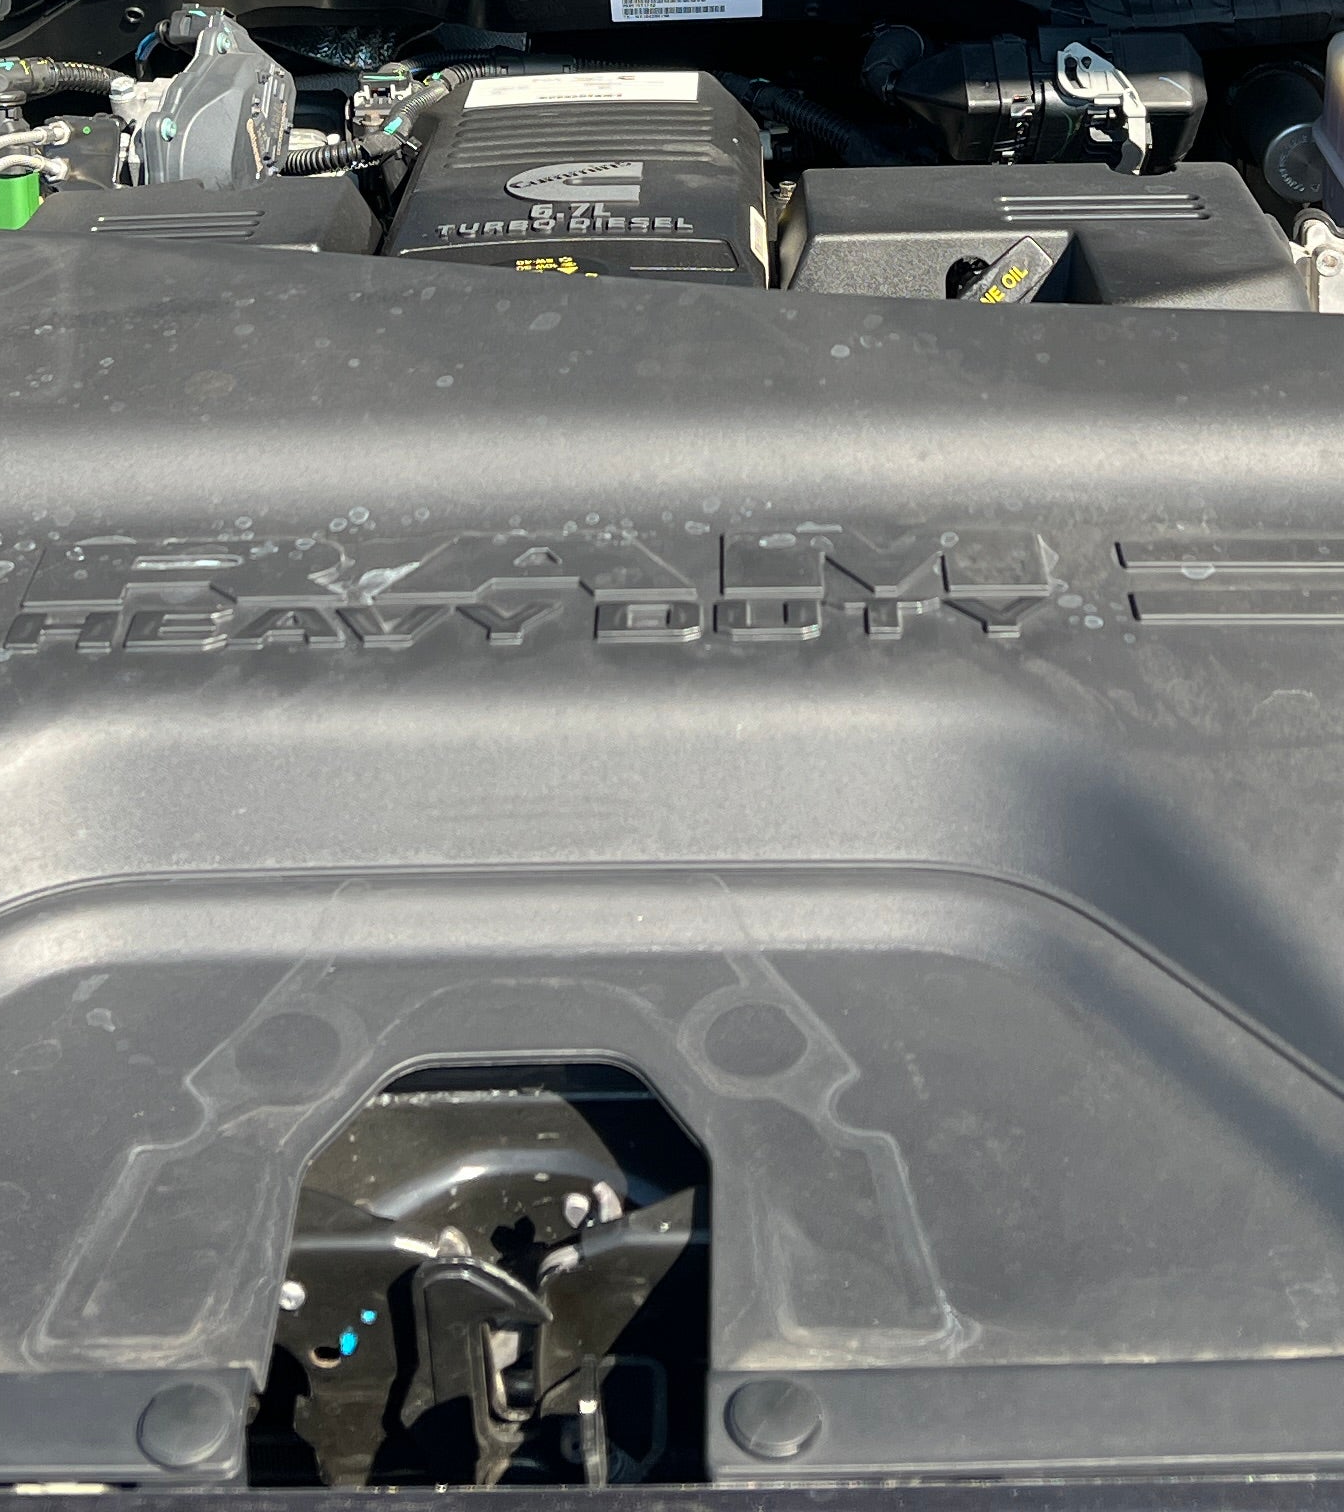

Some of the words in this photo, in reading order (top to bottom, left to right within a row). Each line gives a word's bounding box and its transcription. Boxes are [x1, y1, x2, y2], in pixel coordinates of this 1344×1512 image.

[509, 160, 634, 189] Cummins
[529, 202, 612, 222] 6.7L
[436, 219, 557, 239] TURBO
[567, 216, 694, 234] DIESEL
[1001, 265, 1029, 290] OIL
[19, 532, 1056, 606] RAM
[2, 602, 565, 653] HEAVY
[592, 595, 1052, 645] DUTY
